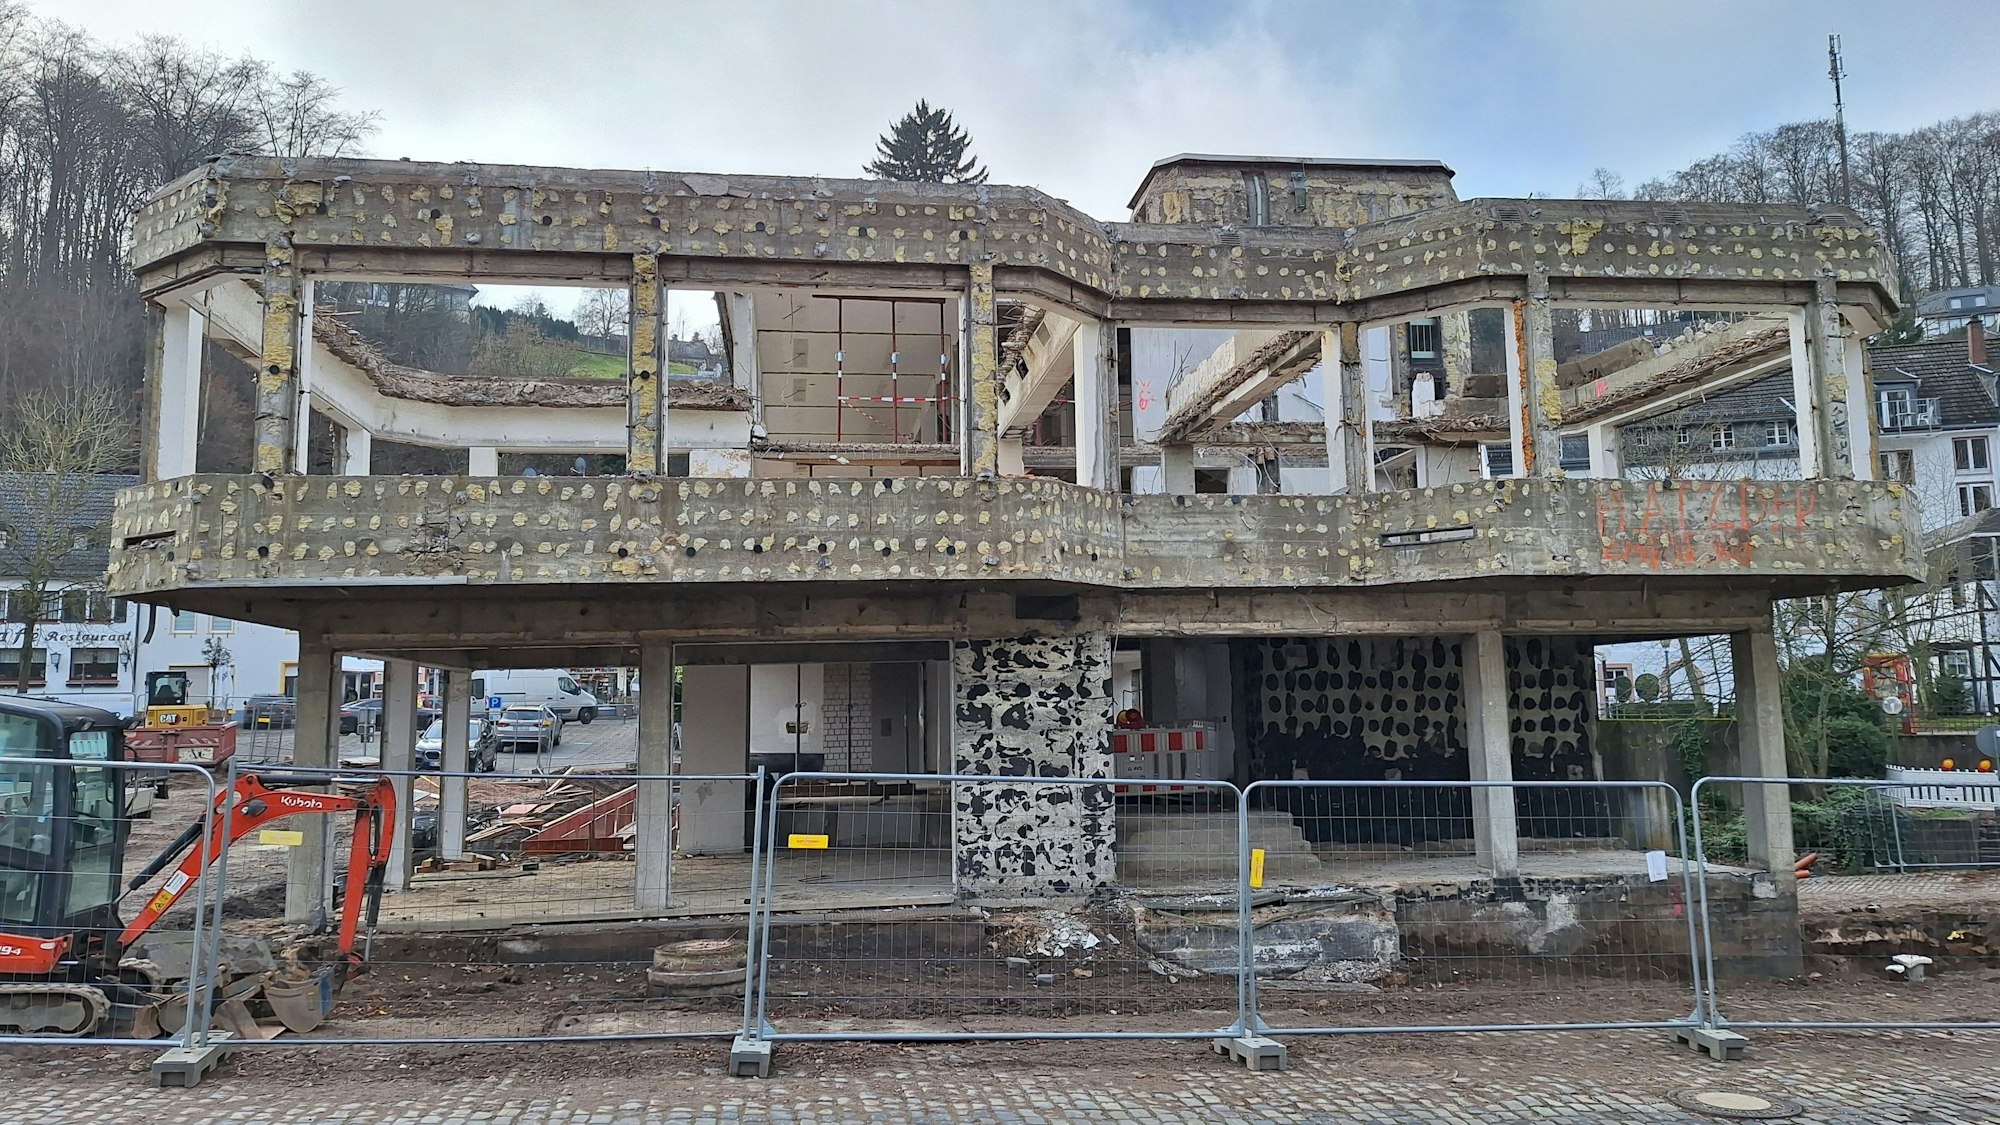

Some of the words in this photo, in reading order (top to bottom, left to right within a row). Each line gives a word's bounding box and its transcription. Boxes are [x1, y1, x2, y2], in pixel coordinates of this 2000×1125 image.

[45, 631, 132, 642] Restaurant
[491, 698, 499, 708] P
[160, 714, 177, 724] CAT
[281, 796, 323, 808] Kubota
